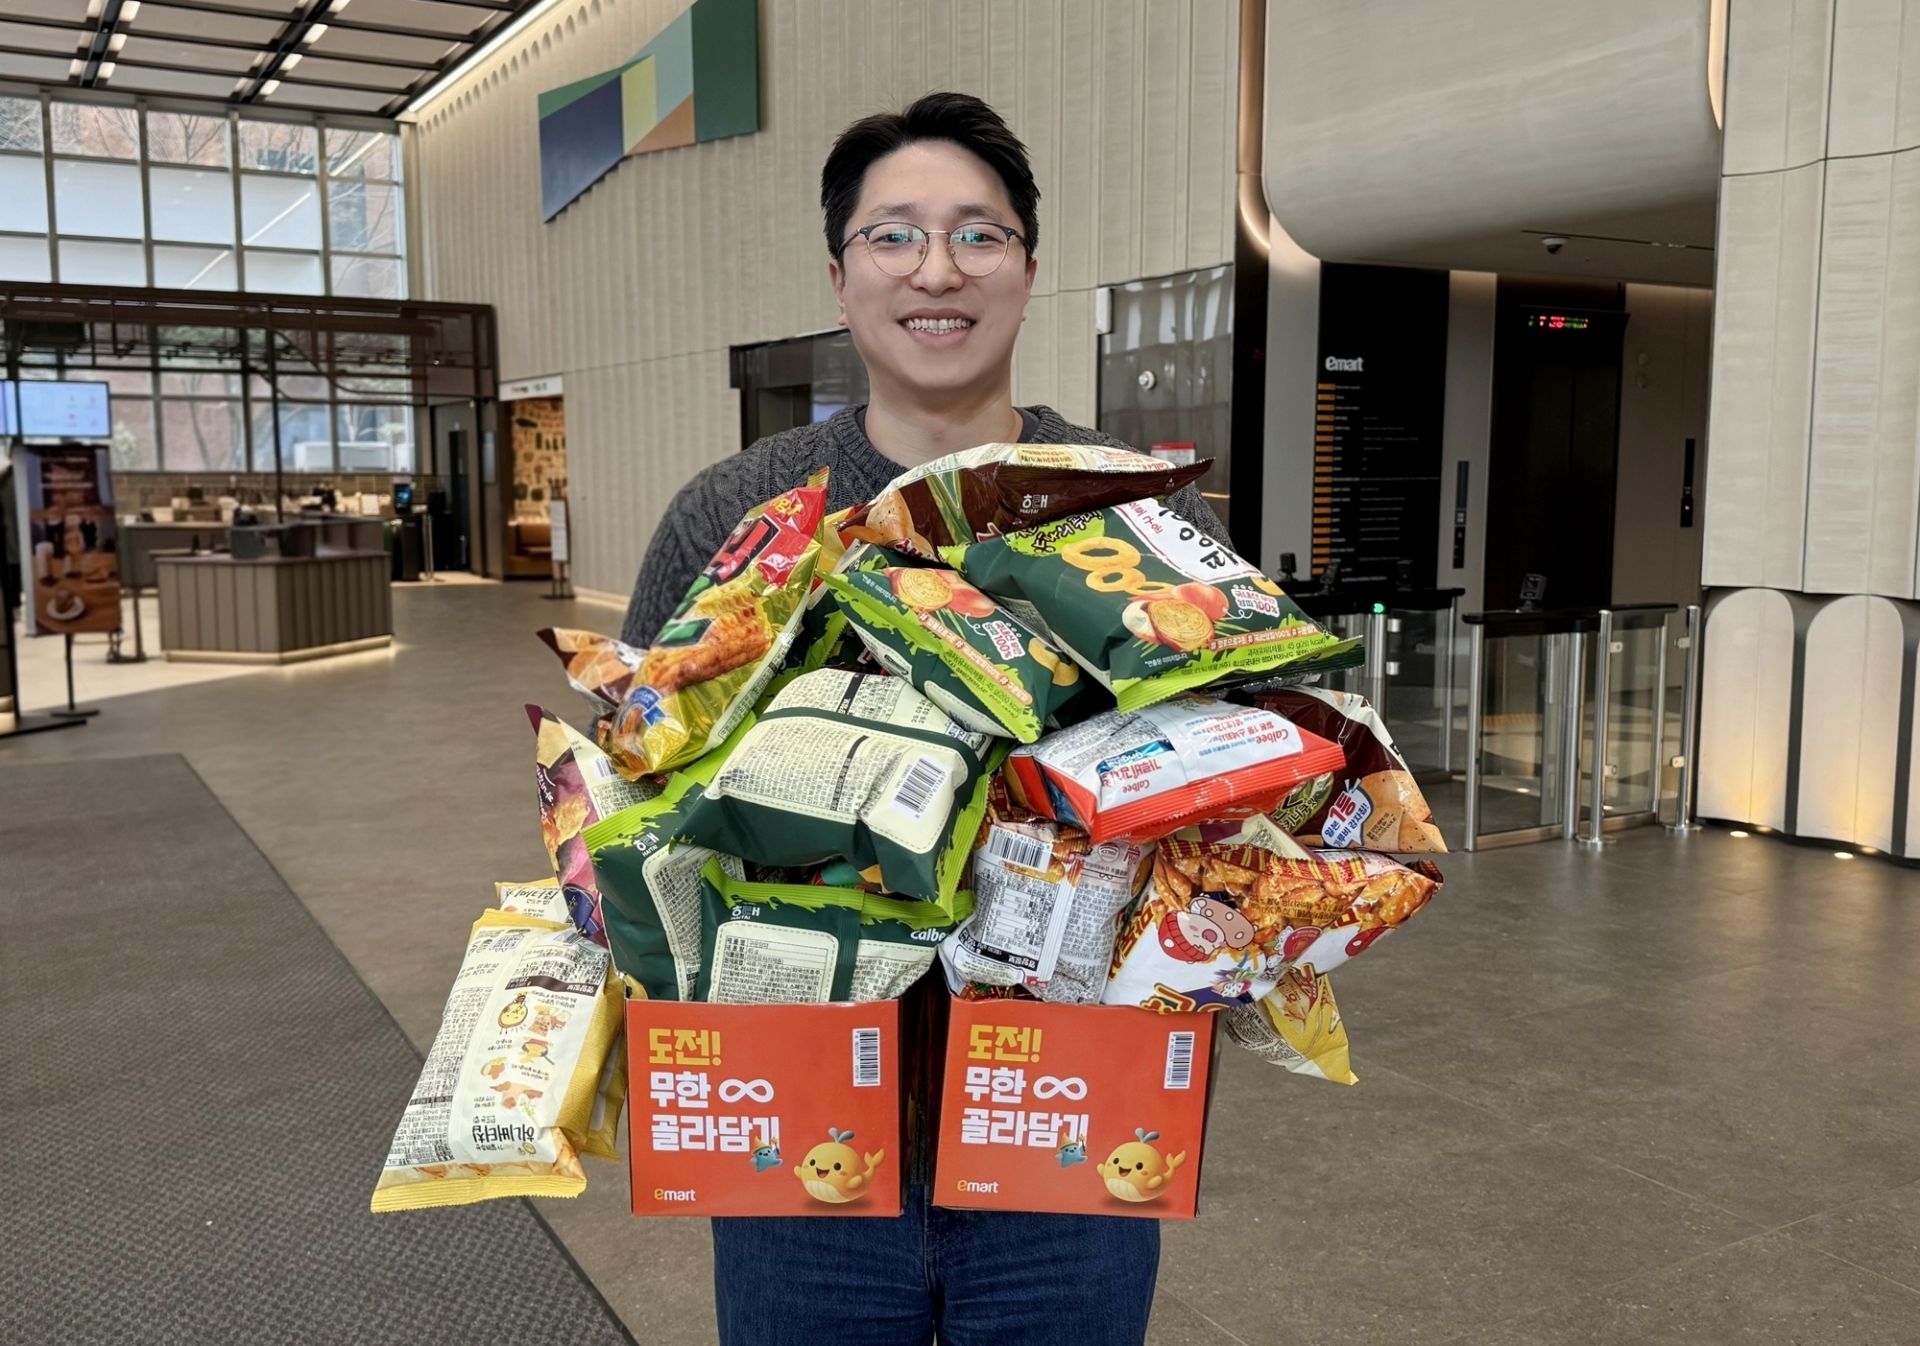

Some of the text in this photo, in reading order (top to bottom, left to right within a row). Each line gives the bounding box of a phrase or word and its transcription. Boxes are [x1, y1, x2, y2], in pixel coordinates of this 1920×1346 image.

[1325, 356, 1364, 373] emart
[1022, 493, 1047, 509] 해태
[1030, 523, 1071, 557] 양파의
[1253, 601, 1280, 616] 100%
[992, 633, 1015, 660] 100%
[1255, 728, 1289, 744] Calbee
[1122, 778, 1151, 795] Calbee
[1324, 793, 1356, 838] 일본 1등
[1333, 803, 1370, 847] 가루비 감자칩!
[633, 832, 660, 851] 해태
[731, 905, 760, 918] 해태
[649, 1028, 722, 1066] 도전!
[967, 1024, 1043, 1063] 도전!
[650, 1070, 711, 1109] 무한
[964, 1066, 1027, 1104] 무한
[472, 1124, 534, 1143] 허니버터칩
[651, 1114, 780, 1152] 골라담기
[961, 1107, 1089, 1148] 골라담기
[654, 1188, 696, 1202] emart
[957, 1179, 999, 1194] emart
